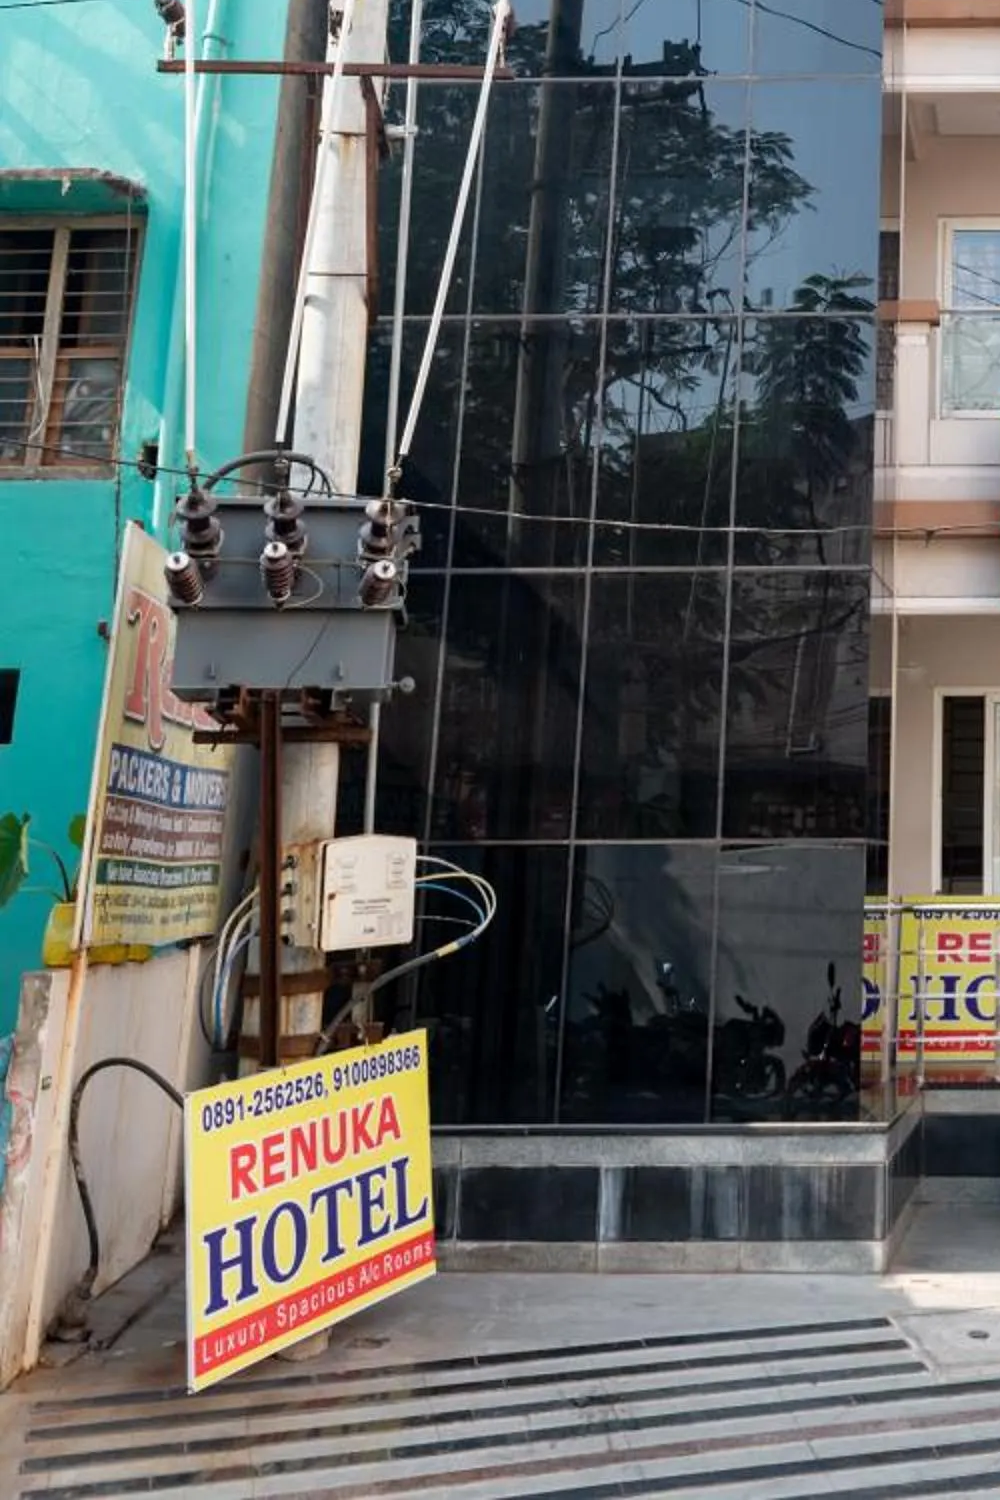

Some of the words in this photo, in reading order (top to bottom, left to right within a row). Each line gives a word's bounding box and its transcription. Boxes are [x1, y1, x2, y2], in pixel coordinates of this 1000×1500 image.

[108, 750, 171, 801] PACKERS
[171, 768, 182, 803] &
[202, 1071, 328, 1132] 0891-2562526,
[333, 1045, 421, 1092] 9100898366
[230, 1096, 402, 1200] RENUKA
[203, 1156, 429, 1316] HOTEL
[202, 1318, 268, 1364] Luxury
[276, 1278, 355, 1329] Spacious
[384, 1240, 433, 1277] Rooms
